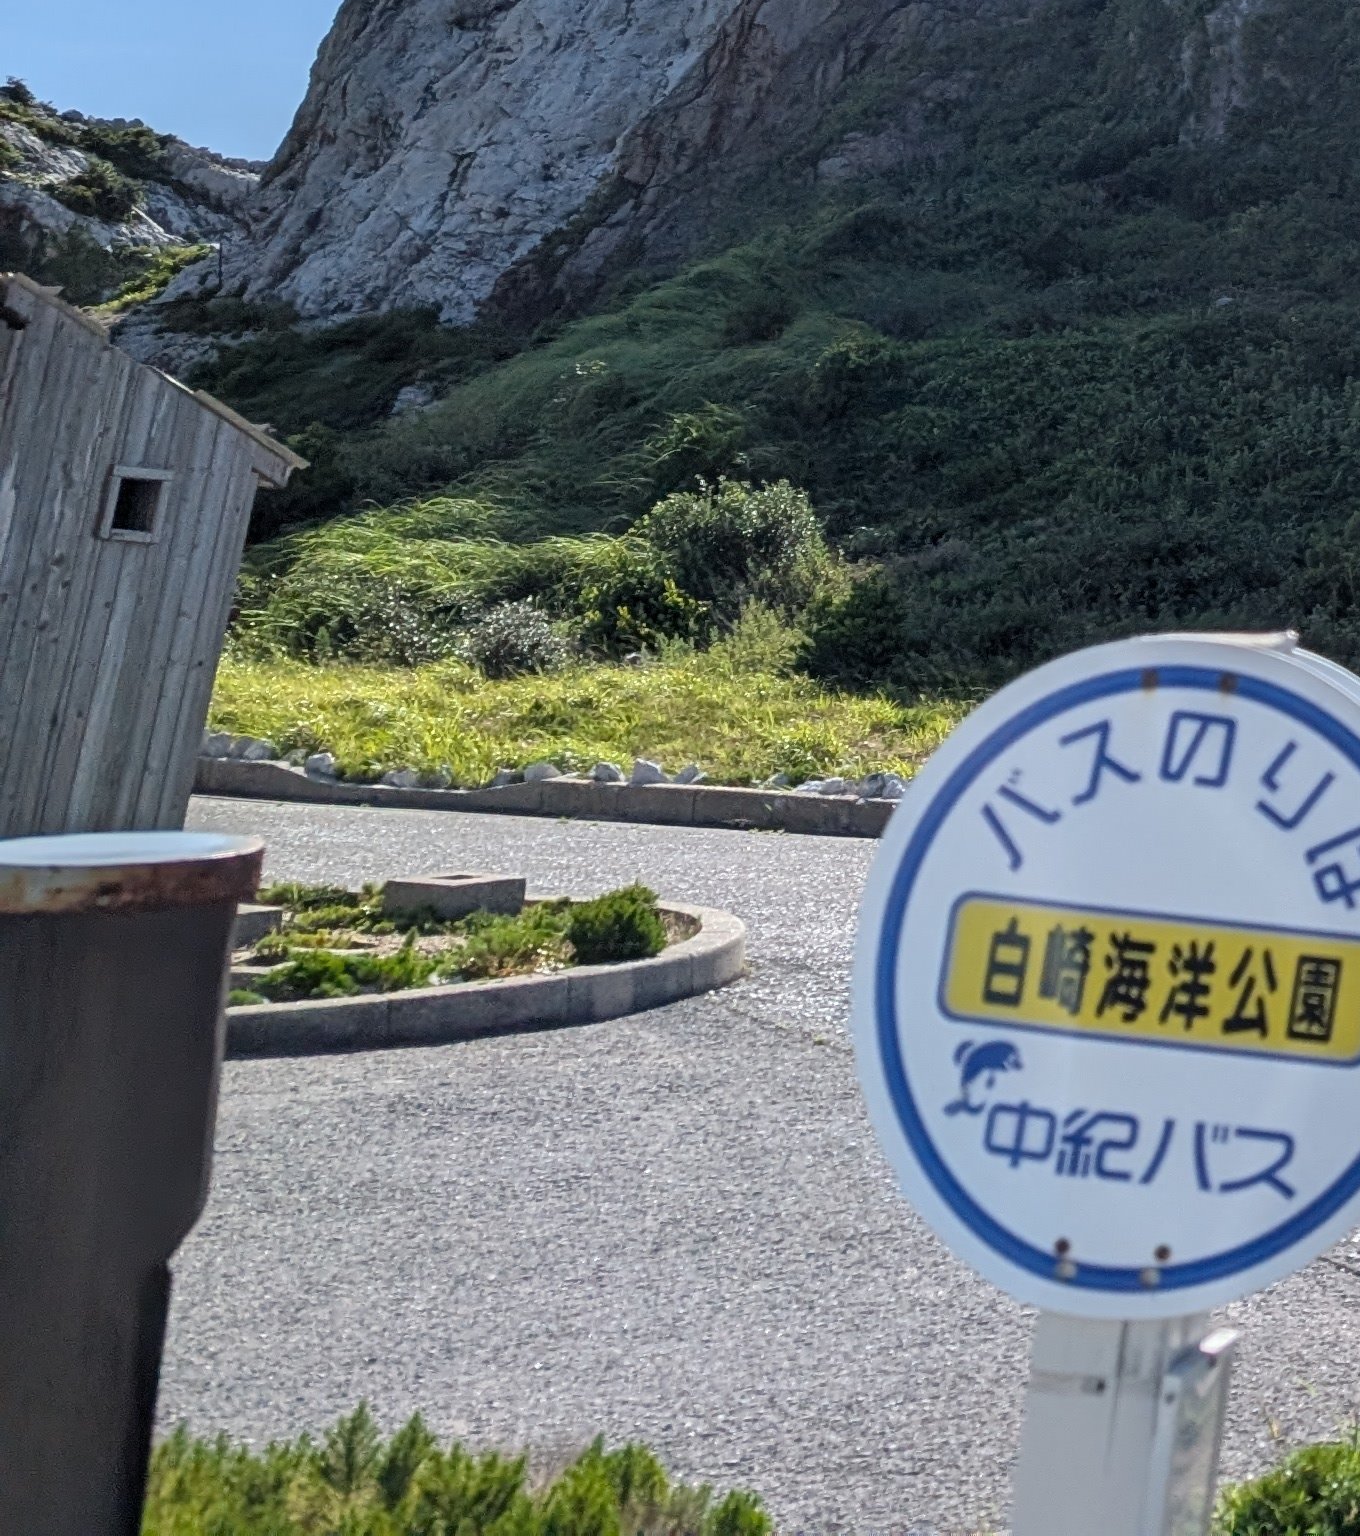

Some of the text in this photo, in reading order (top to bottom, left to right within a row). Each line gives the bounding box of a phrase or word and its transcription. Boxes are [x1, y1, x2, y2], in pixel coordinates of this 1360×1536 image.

[982, 917, 1342, 1045] 白崎海洋公園
[983, 1100, 1297, 1201] 中紀バス
